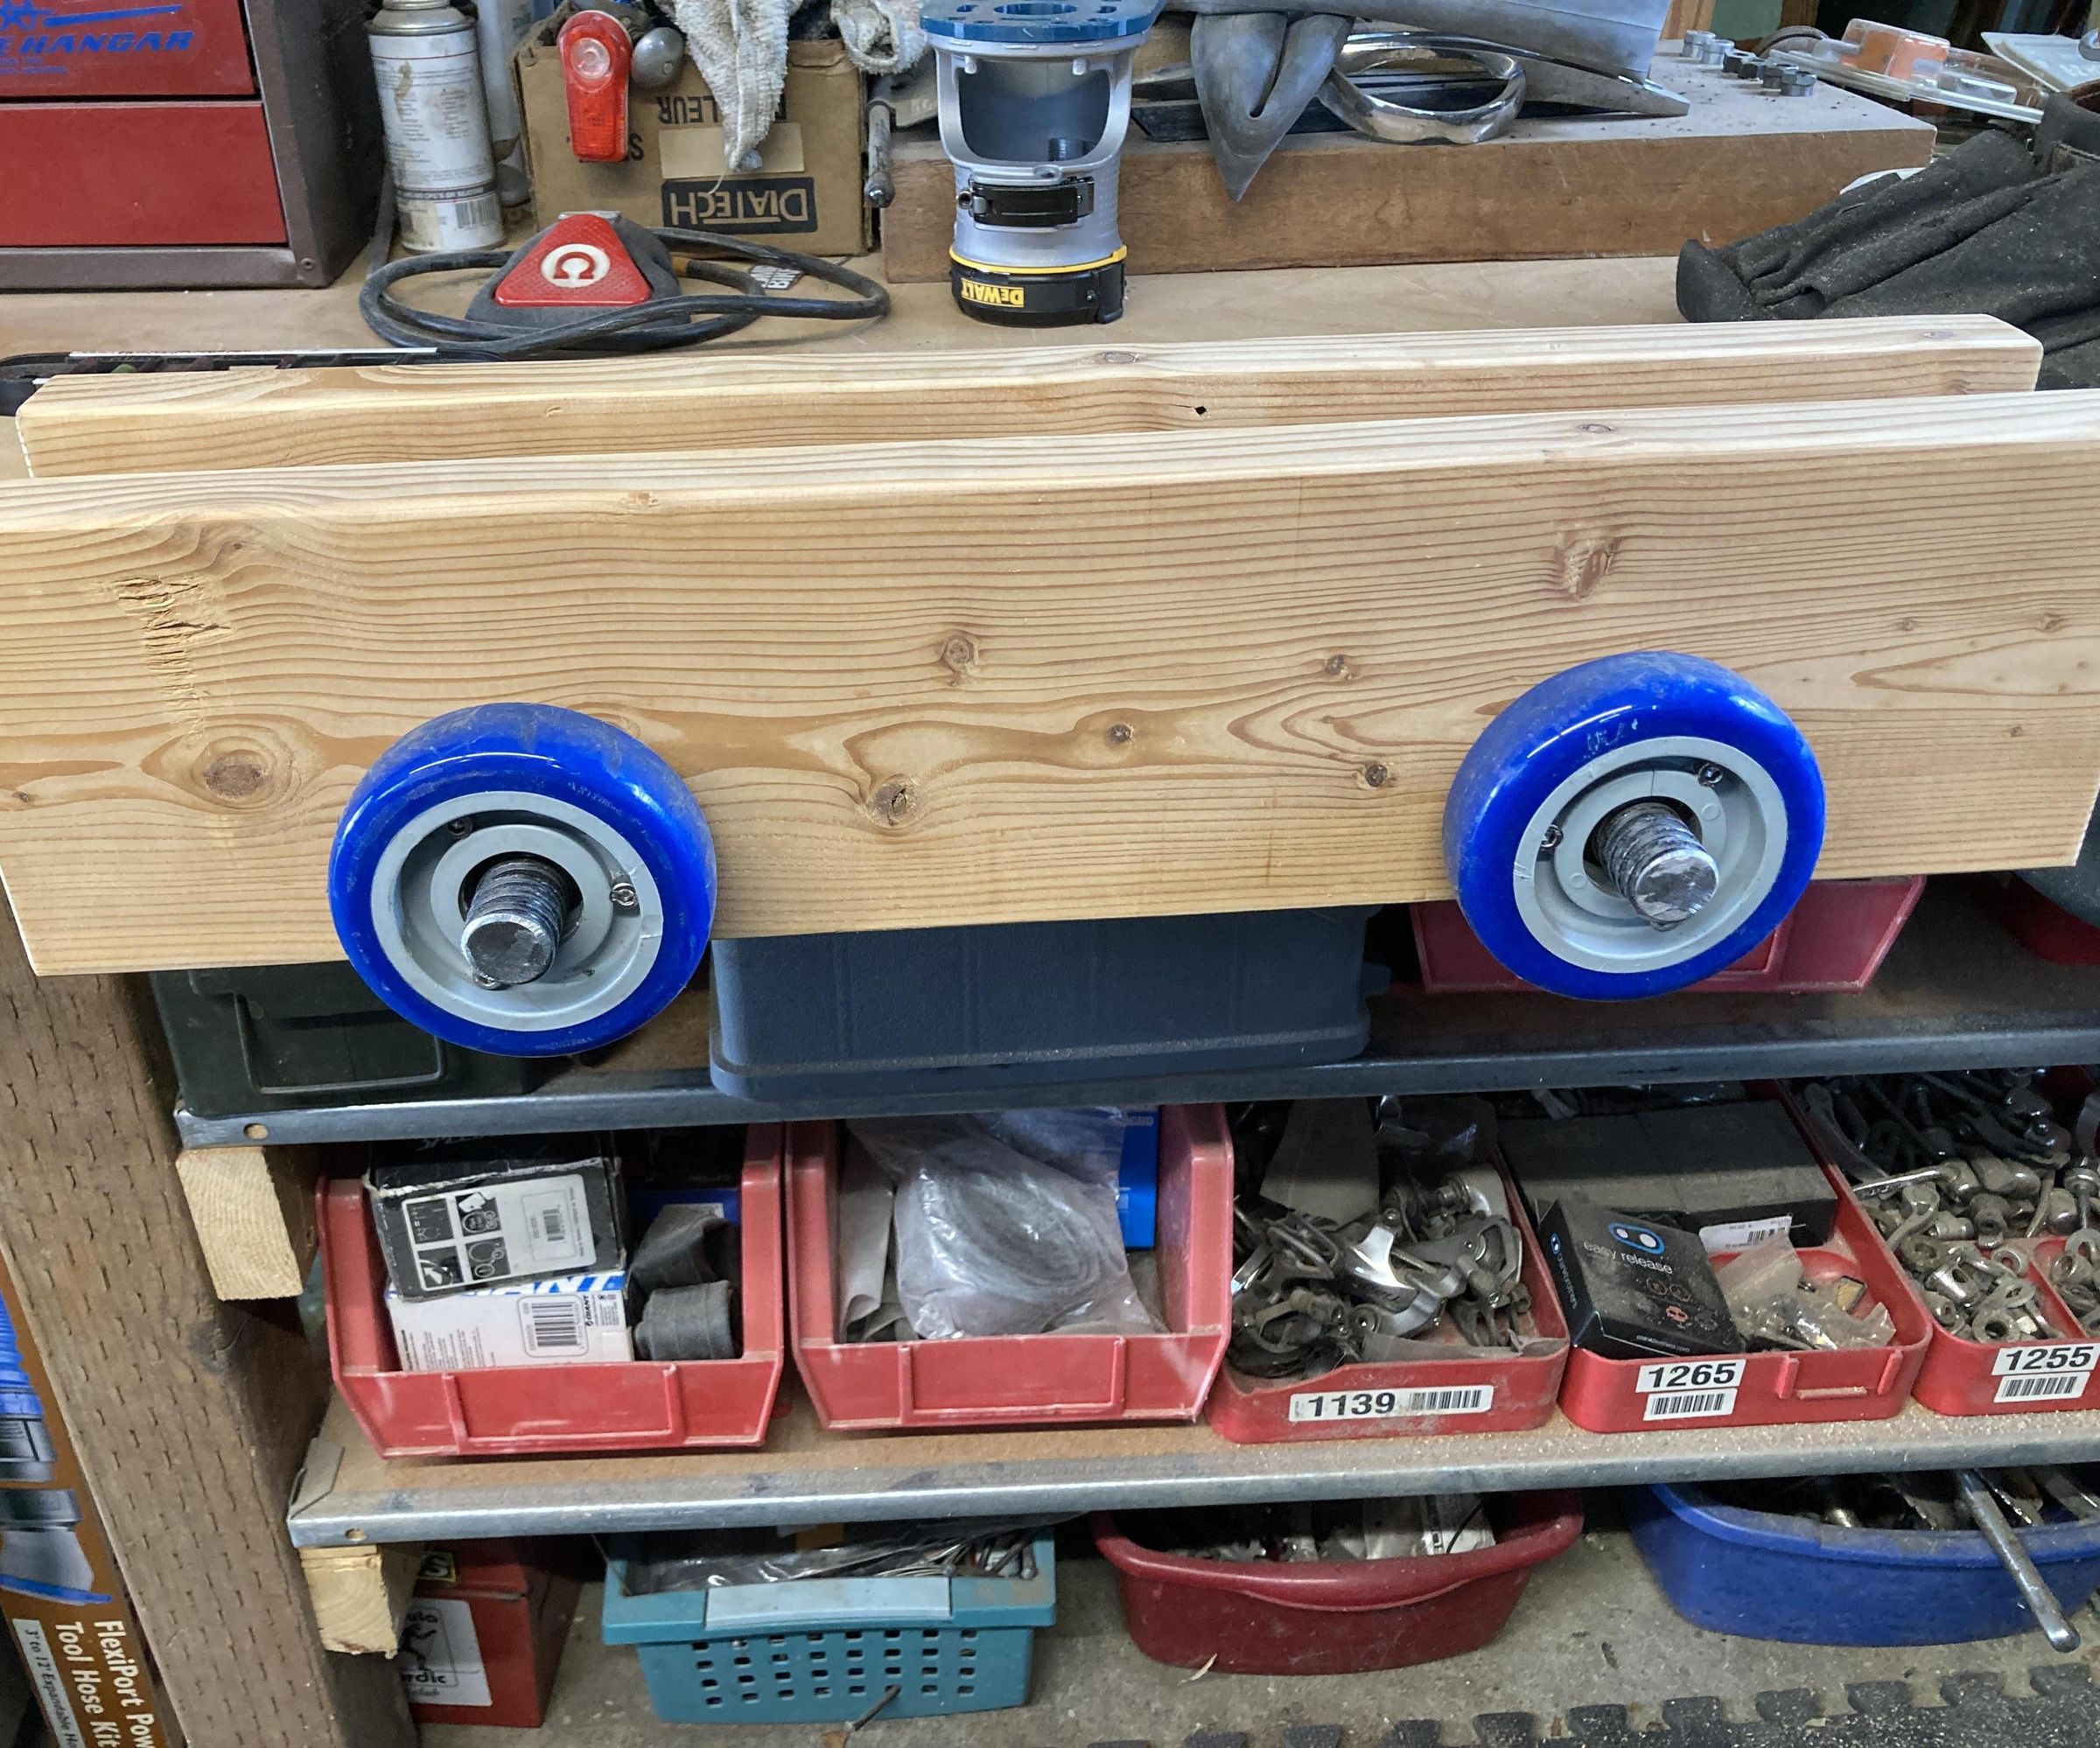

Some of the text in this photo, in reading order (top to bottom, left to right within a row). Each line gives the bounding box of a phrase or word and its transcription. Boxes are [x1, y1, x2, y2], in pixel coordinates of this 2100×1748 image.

[18, 30, 194, 54] HANGAR
[1583, 1241, 1674, 1275] easy release
[583, 1295, 593, 1320] GIANT
[2006, 1346, 2095, 1372] 1255
[1647, 1362, 1737, 1388] 1265
[1306, 1392, 1396, 1417] 1139
[30, 1641, 41, 1653] to
[55, 1620, 122, 1748] Tool Hose Kit
[94, 1620, 158, 1748] FlexiPort Pow
